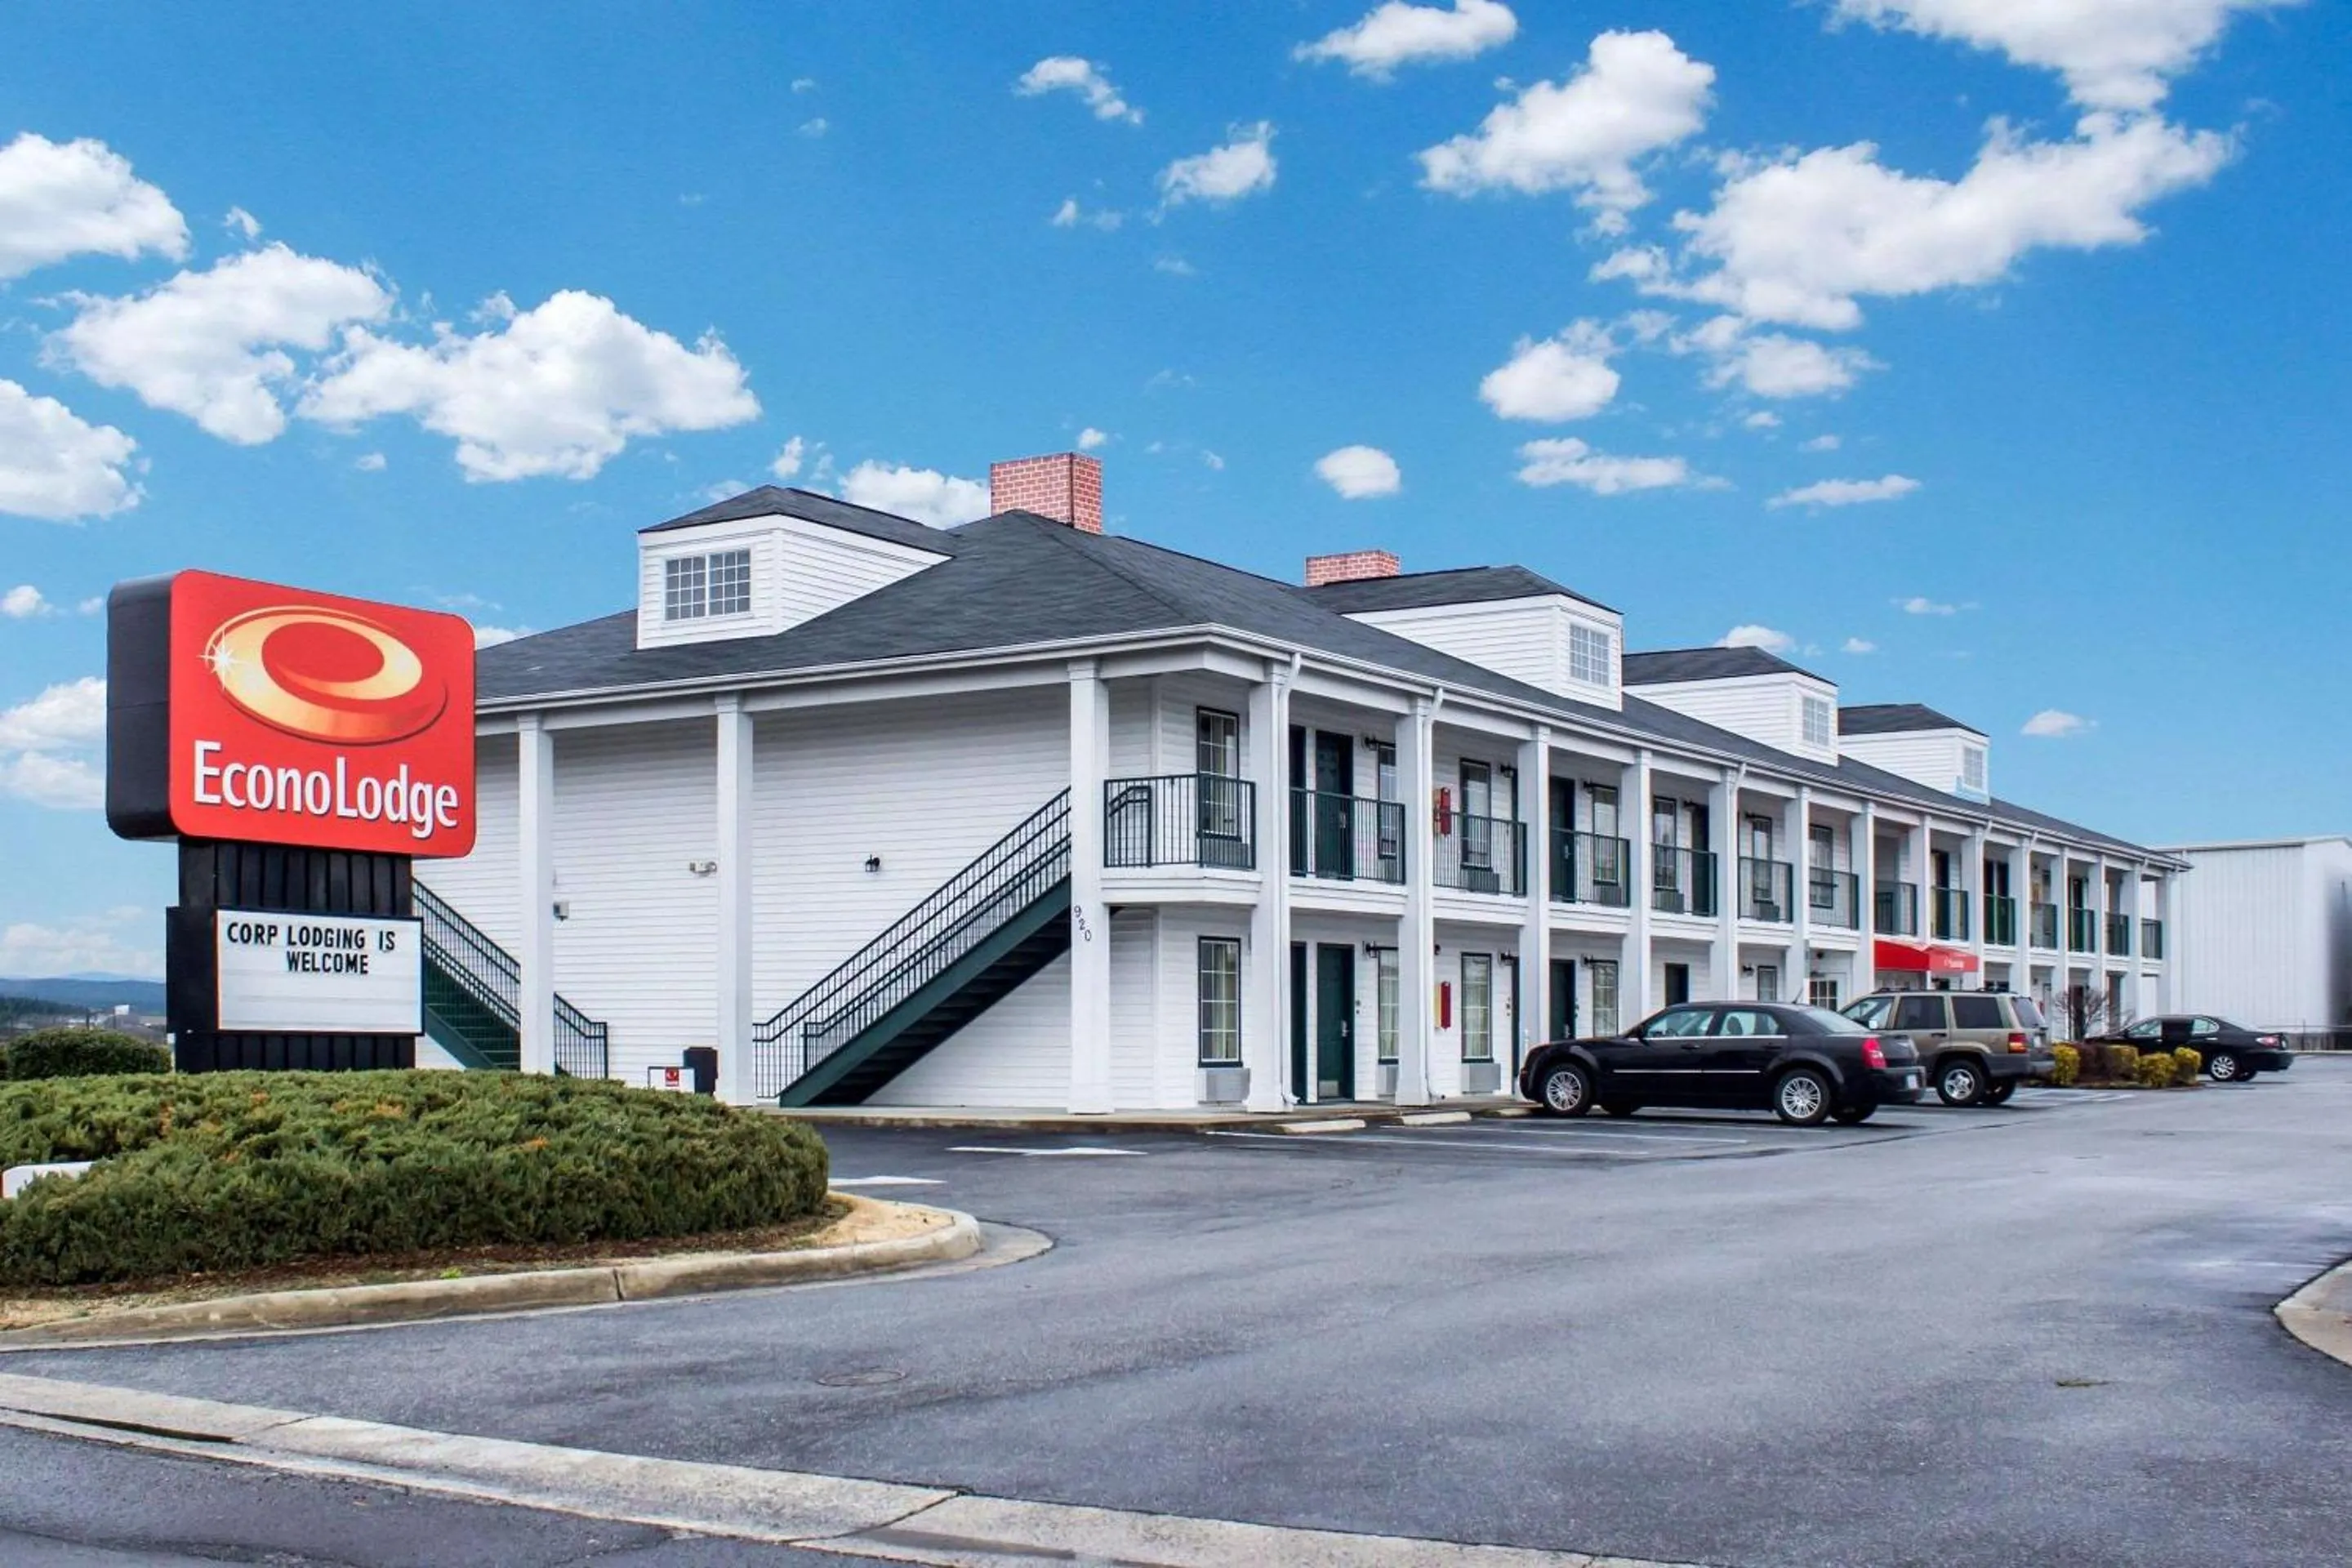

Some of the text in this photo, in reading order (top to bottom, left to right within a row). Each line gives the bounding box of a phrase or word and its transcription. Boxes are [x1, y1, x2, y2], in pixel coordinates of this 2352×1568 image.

[227, 921, 396, 951] CORP LODGING IS
[1073, 905, 1092, 942] 920
[287, 951, 369, 975] WELCOME
